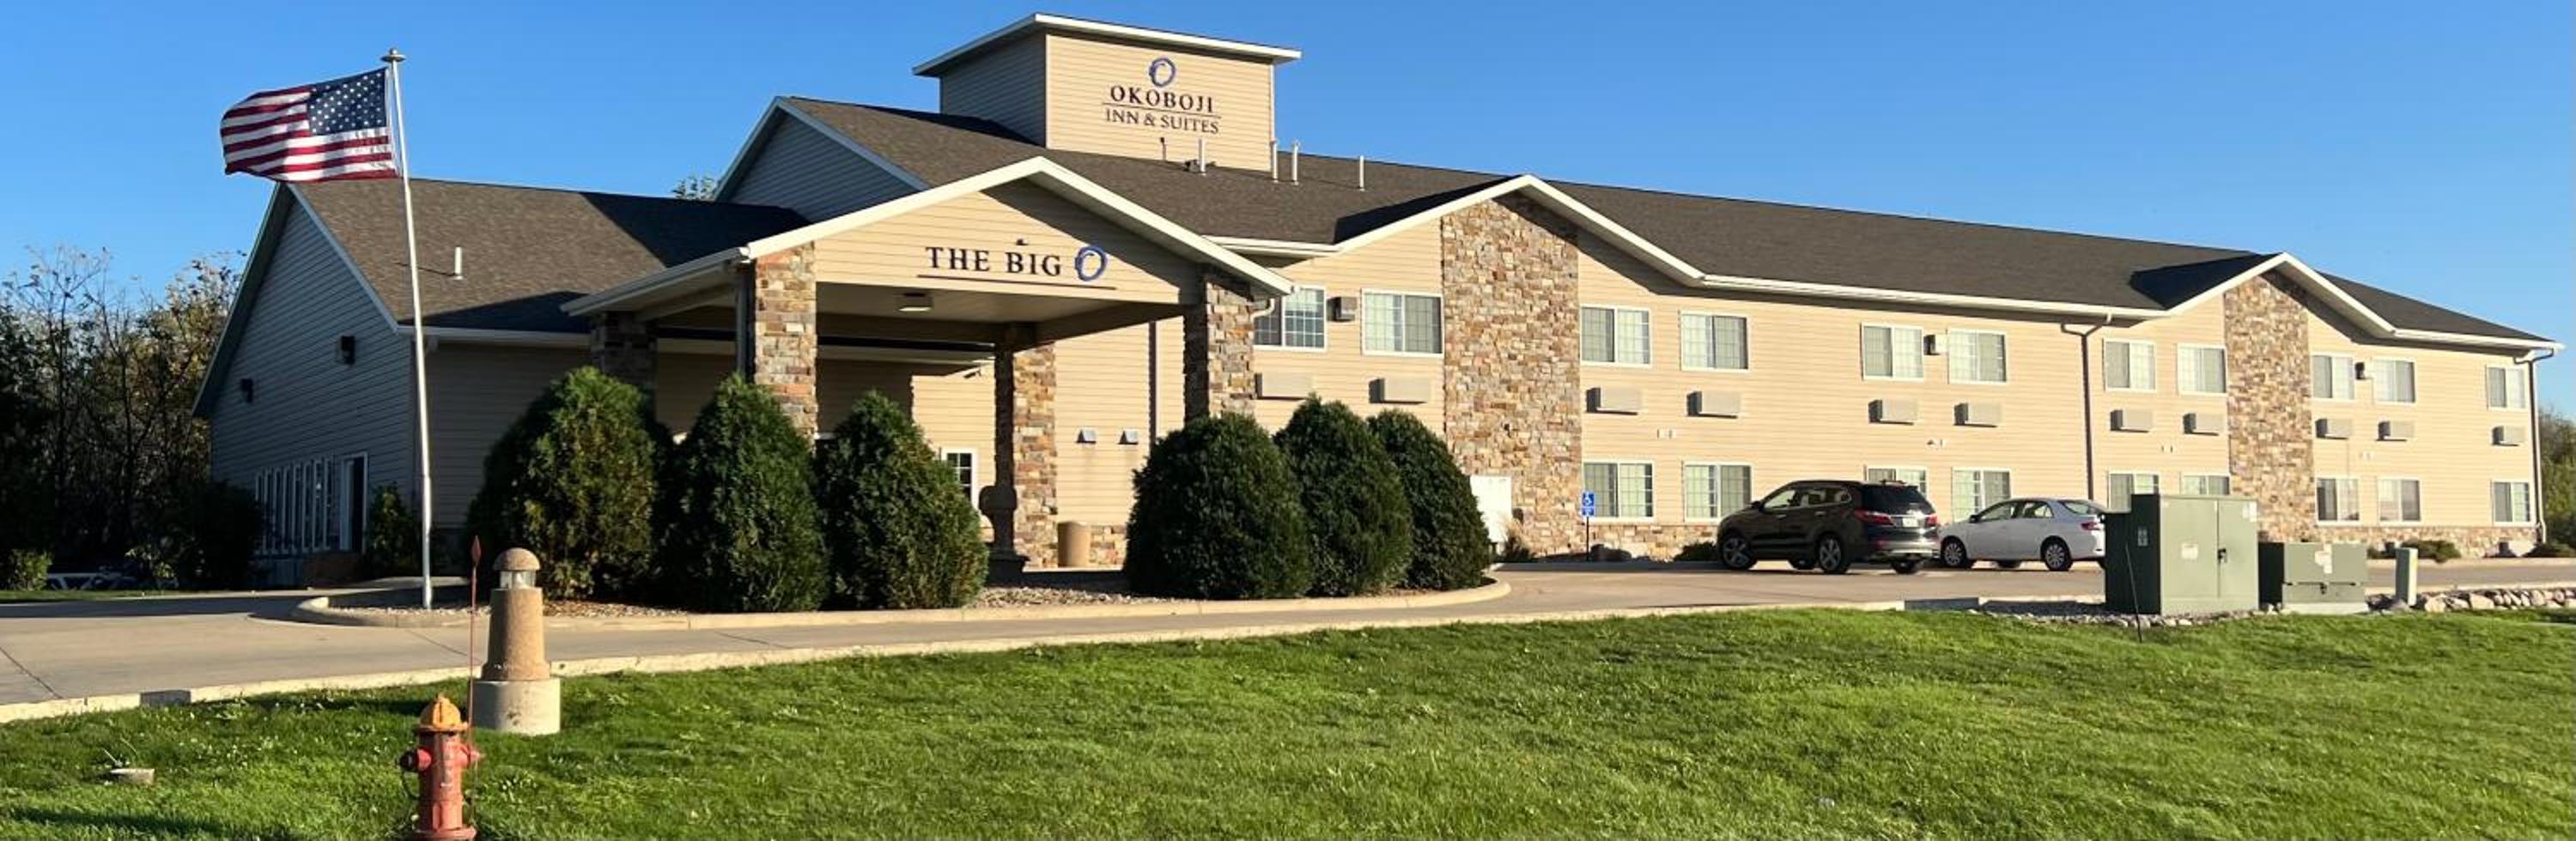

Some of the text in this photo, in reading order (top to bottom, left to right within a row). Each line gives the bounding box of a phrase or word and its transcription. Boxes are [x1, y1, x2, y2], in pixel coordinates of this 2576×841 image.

[1110, 85, 1213, 113] OKOBOJI
[1106, 108, 1219, 134] INN & SUITES
[926, 246, 991, 272] THE
[1005, 251, 1063, 277] BIG
